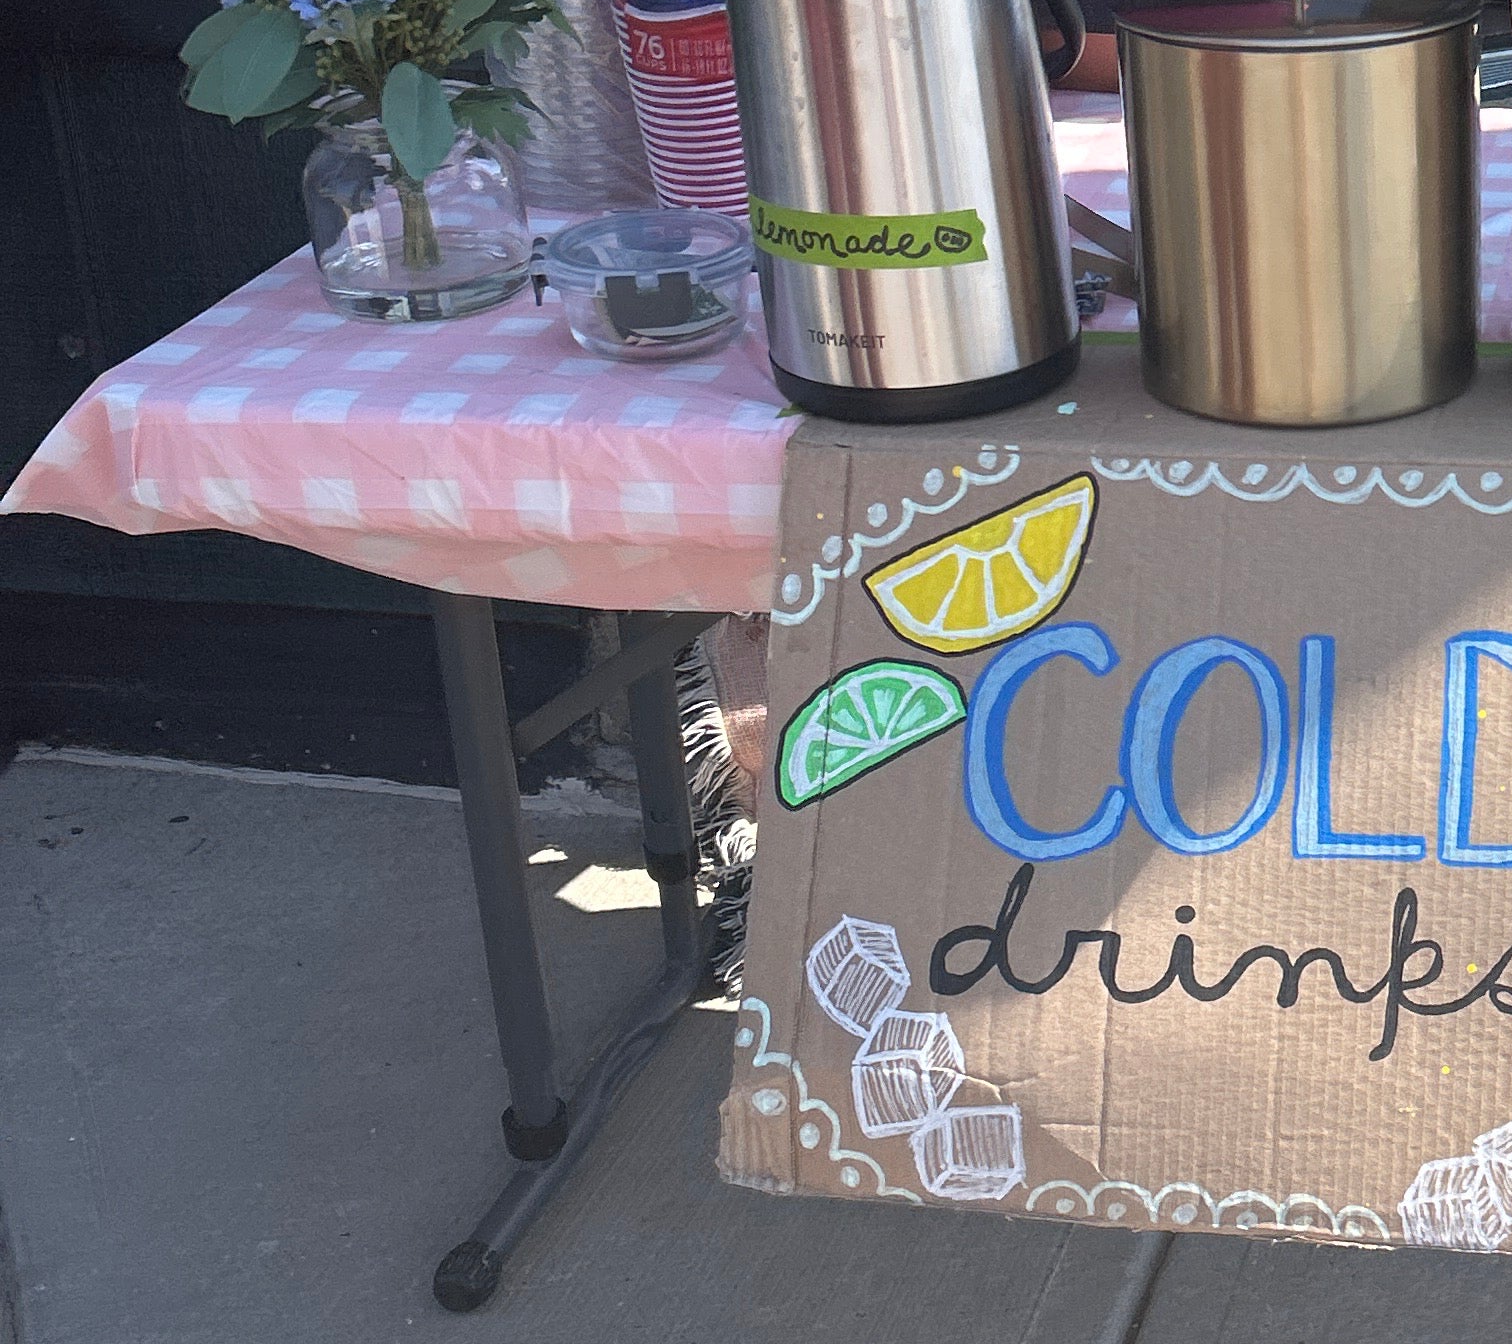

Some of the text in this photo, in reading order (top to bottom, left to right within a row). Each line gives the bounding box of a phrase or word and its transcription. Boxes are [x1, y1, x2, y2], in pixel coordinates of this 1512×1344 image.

[632, 29, 665, 60] 76
[756, 205, 932, 260] lemonade
[808, 327, 887, 350] TOMAKEIT
